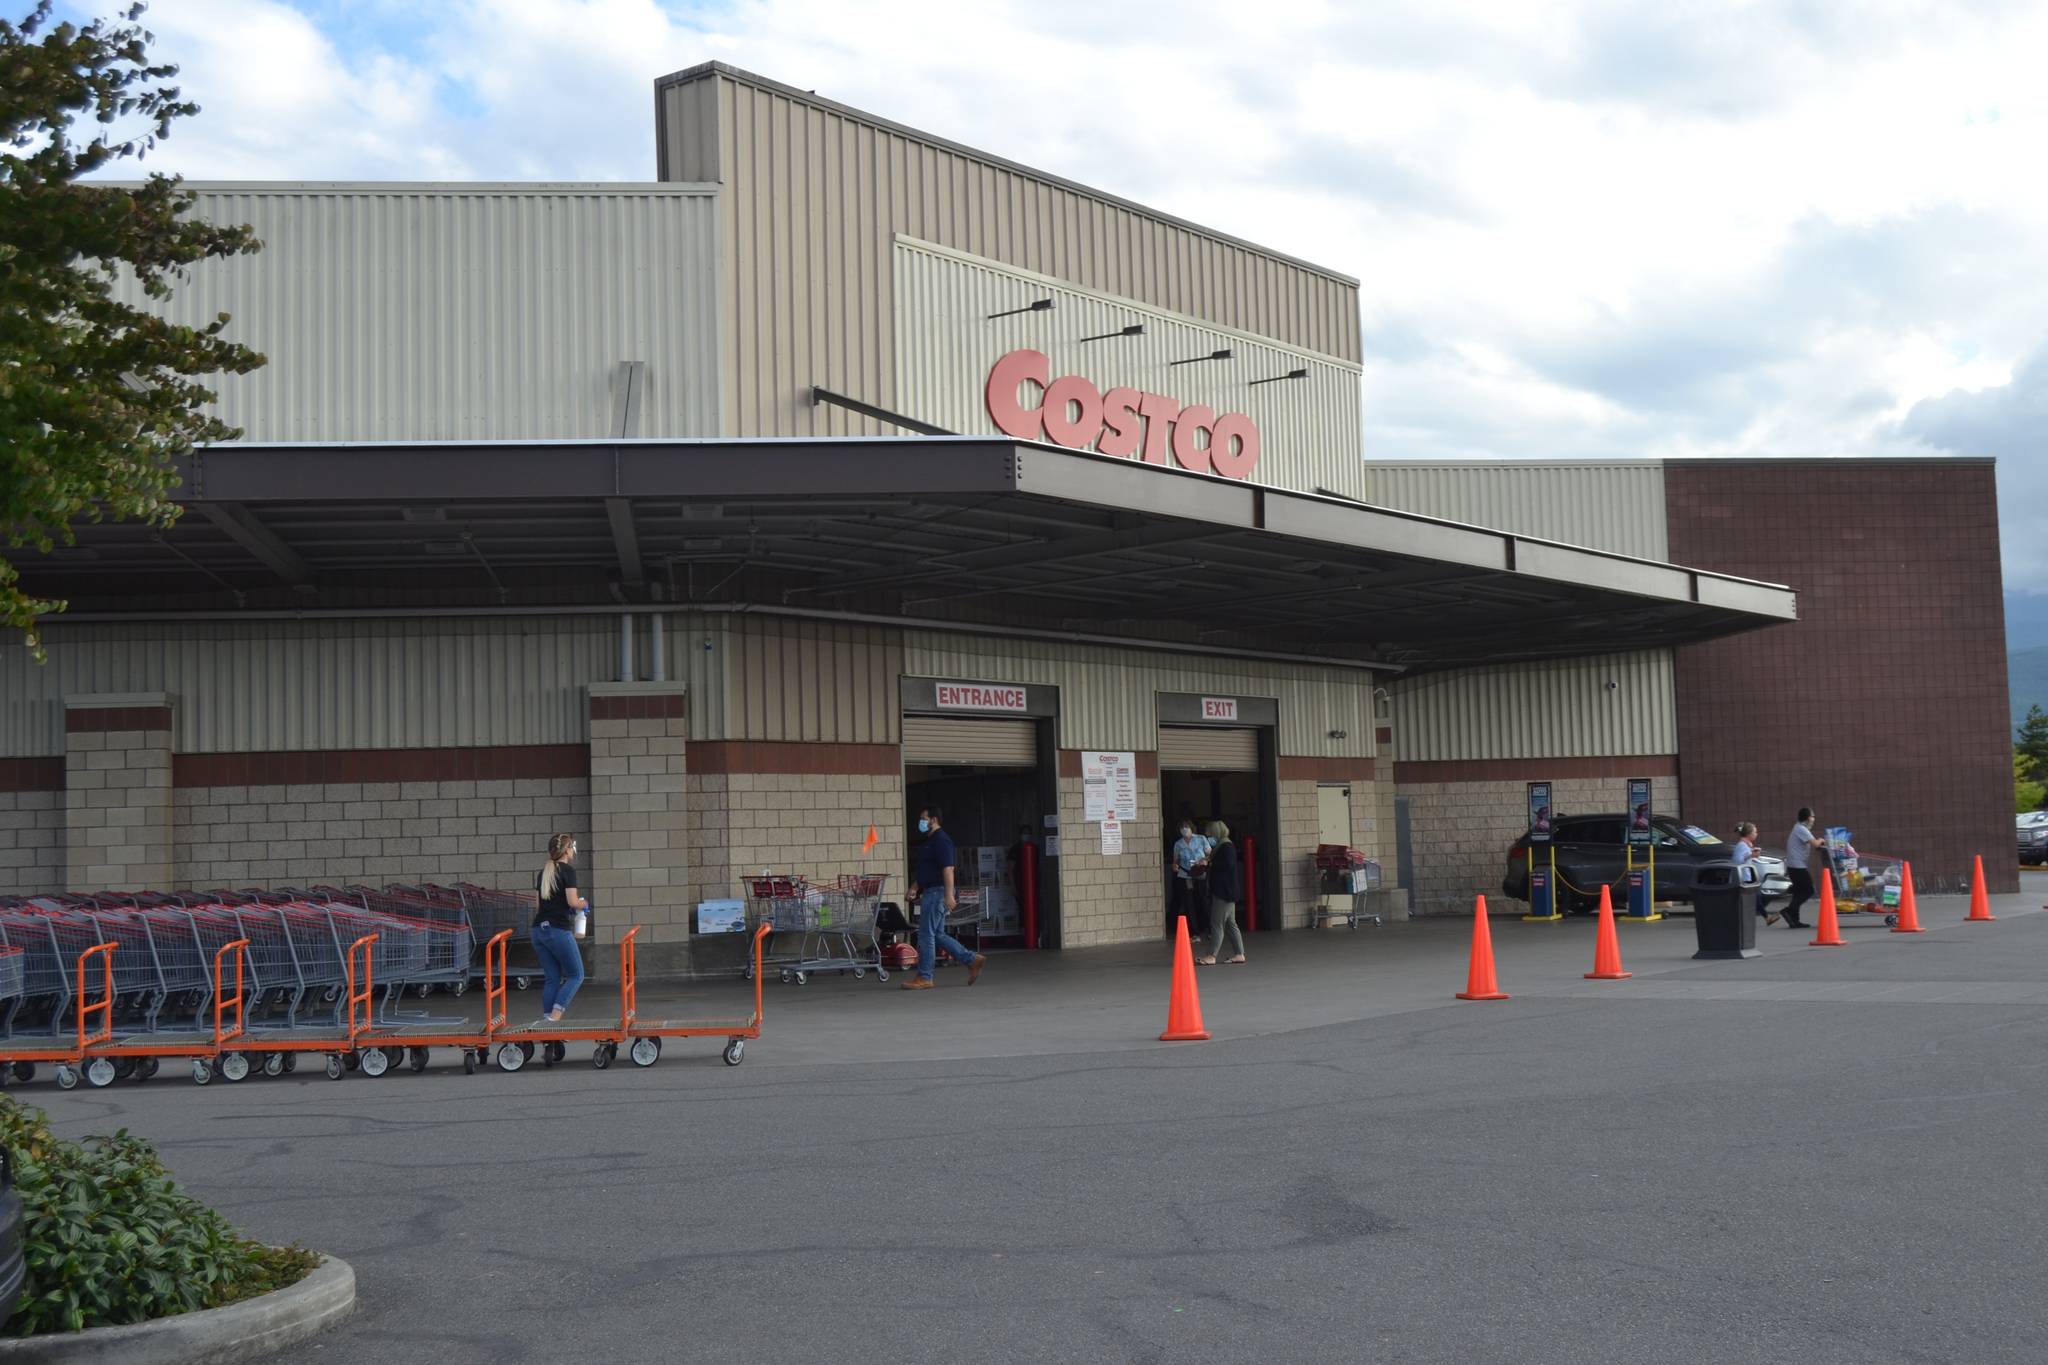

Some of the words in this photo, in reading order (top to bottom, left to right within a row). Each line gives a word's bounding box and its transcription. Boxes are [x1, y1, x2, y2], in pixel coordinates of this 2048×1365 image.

[986, 349, 1260, 480] COSTCO
[938, 686, 1025, 708] ENTRANCE
[1205, 701, 1233, 717] EXIT
